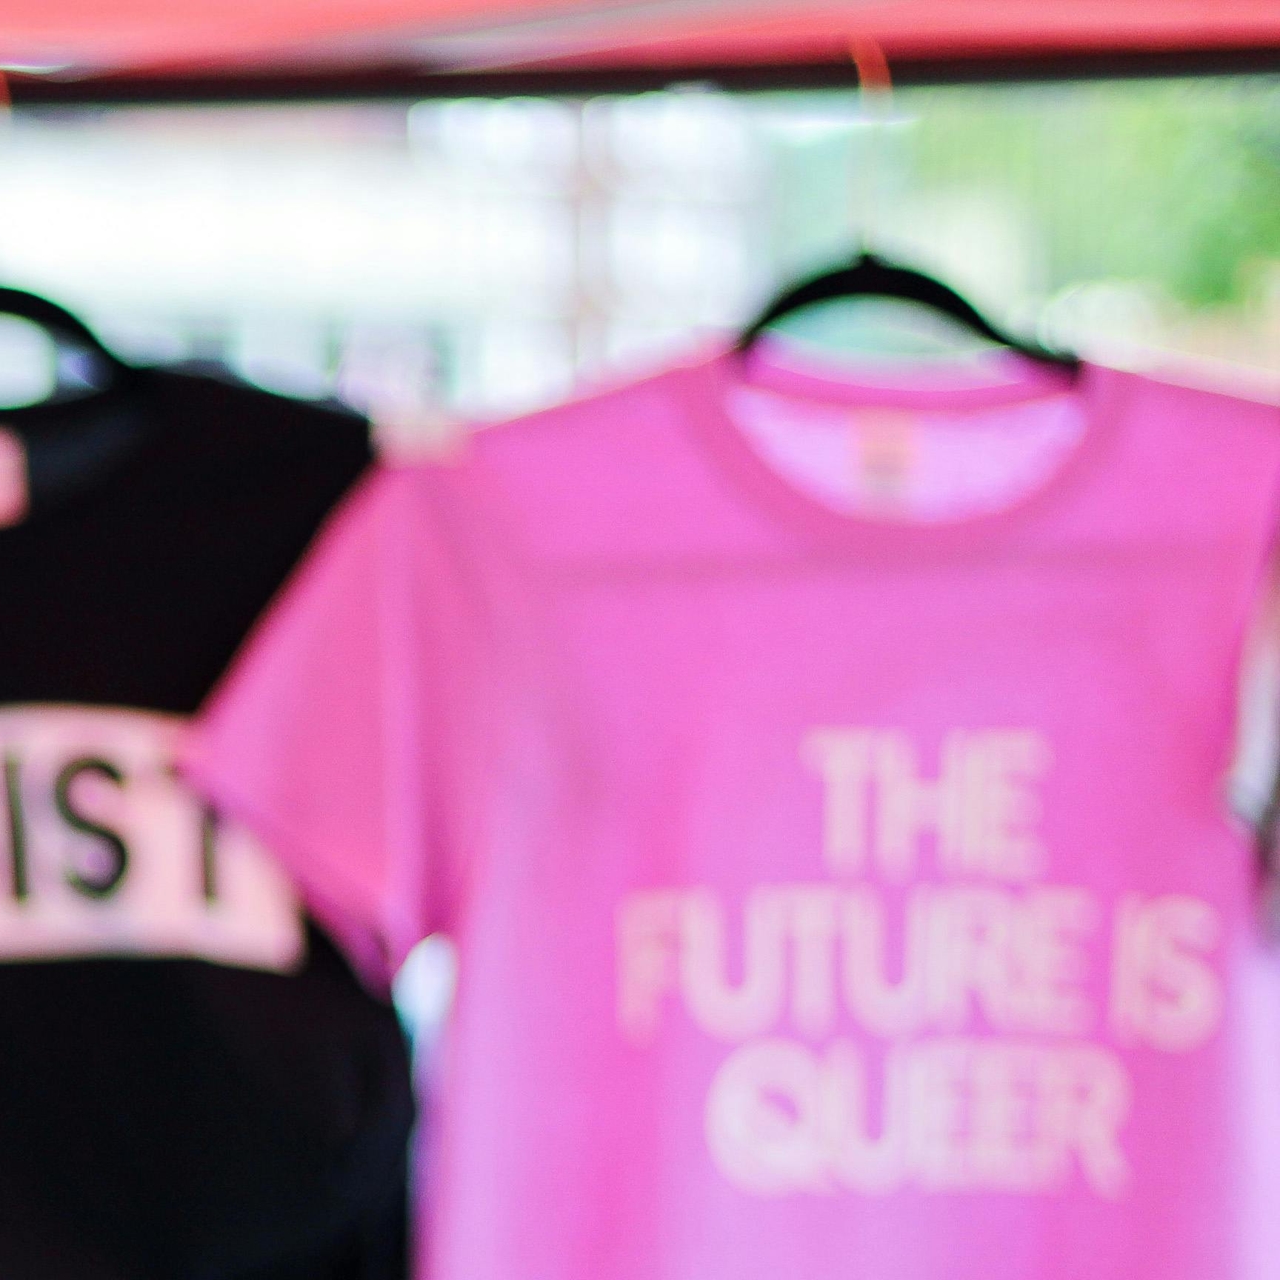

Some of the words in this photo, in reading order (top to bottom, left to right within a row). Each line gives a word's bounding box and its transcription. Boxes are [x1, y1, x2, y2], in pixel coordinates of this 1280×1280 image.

[802, 725, 1050, 888] THE
[615, 880, 1096, 1052] FUTURE
[1110, 888, 1228, 1055] IS
[702, 1035, 1134, 1202] QUEER
